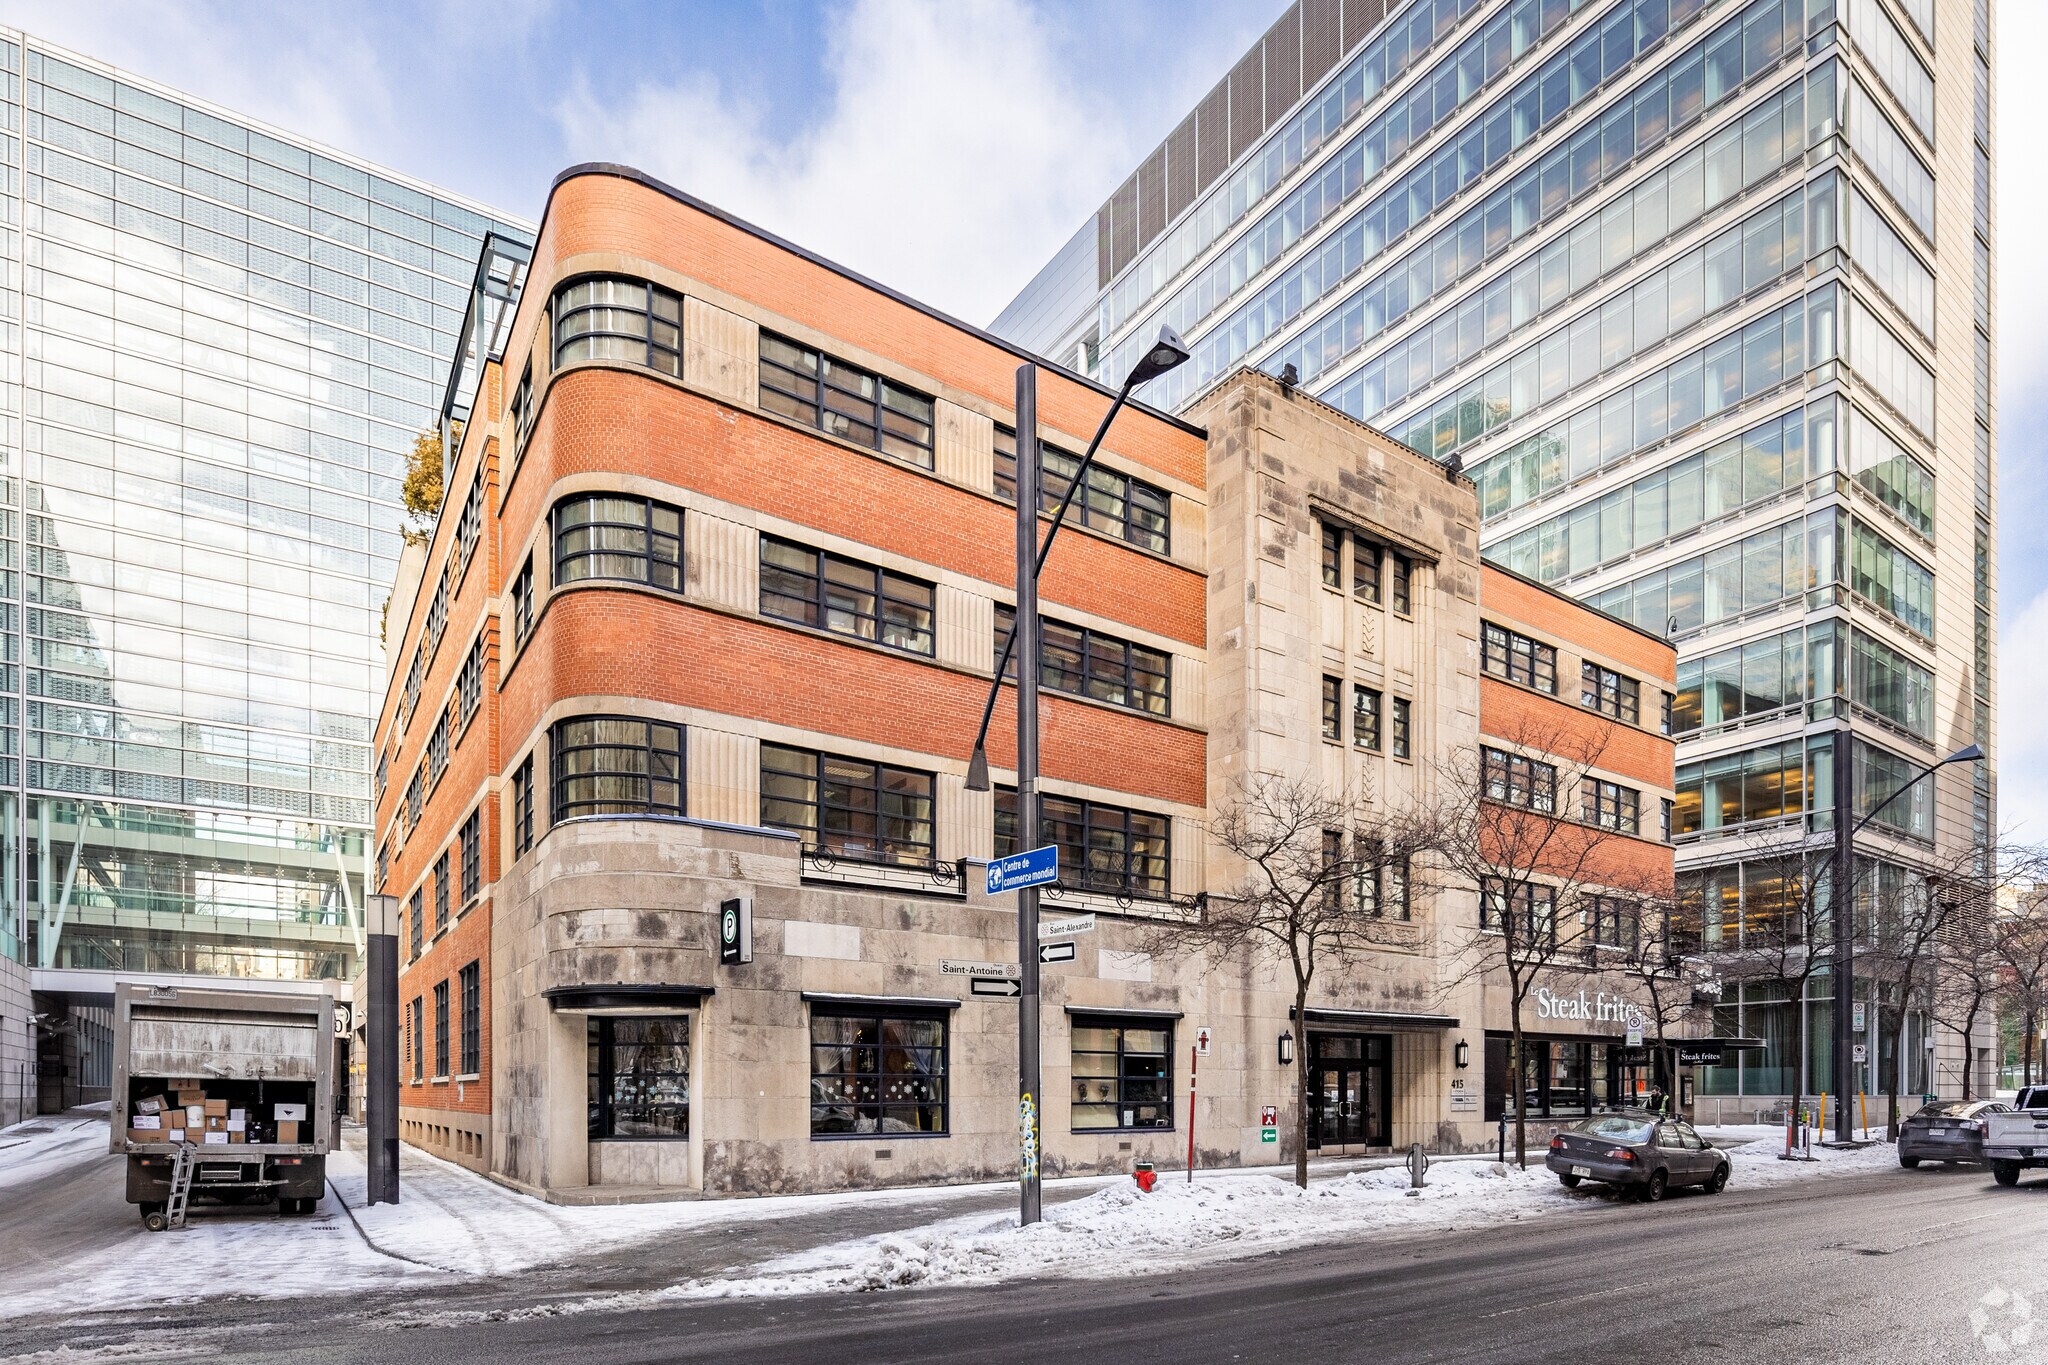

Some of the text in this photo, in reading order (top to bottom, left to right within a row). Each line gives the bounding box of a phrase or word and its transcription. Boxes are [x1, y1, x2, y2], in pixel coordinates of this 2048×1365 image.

[1004, 858, 1030, 872] Centre de
[1004, 866, 1055, 887] commerce mondial
[727, 918, 733, 936] P
[1050, 921, 1093, 934] Saint-Alexandre
[942, 964, 1003, 976] Saint-Antoine
[1538, 987, 1643, 1022] Steak frites
[1680, 1053, 1700, 1061] Steak
[1451, 1079, 1464, 1089] 415
